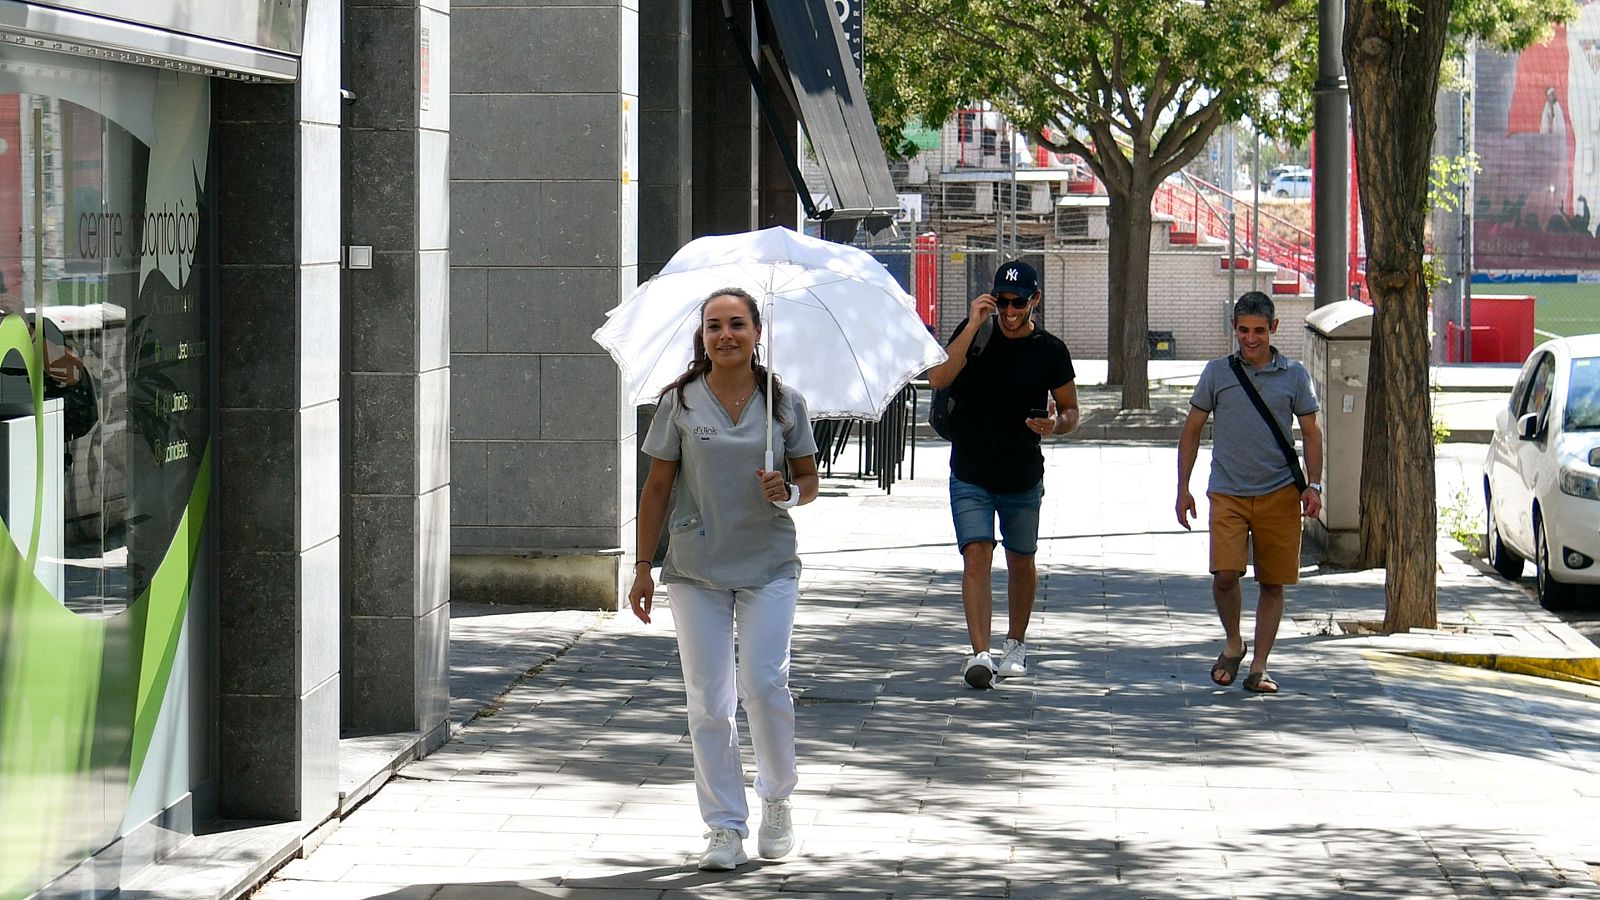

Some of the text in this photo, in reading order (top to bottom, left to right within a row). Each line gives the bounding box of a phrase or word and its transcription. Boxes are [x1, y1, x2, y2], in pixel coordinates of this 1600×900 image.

[79, 198, 200, 268] centre odontològi
[1006, 268, 1018, 281] NY
